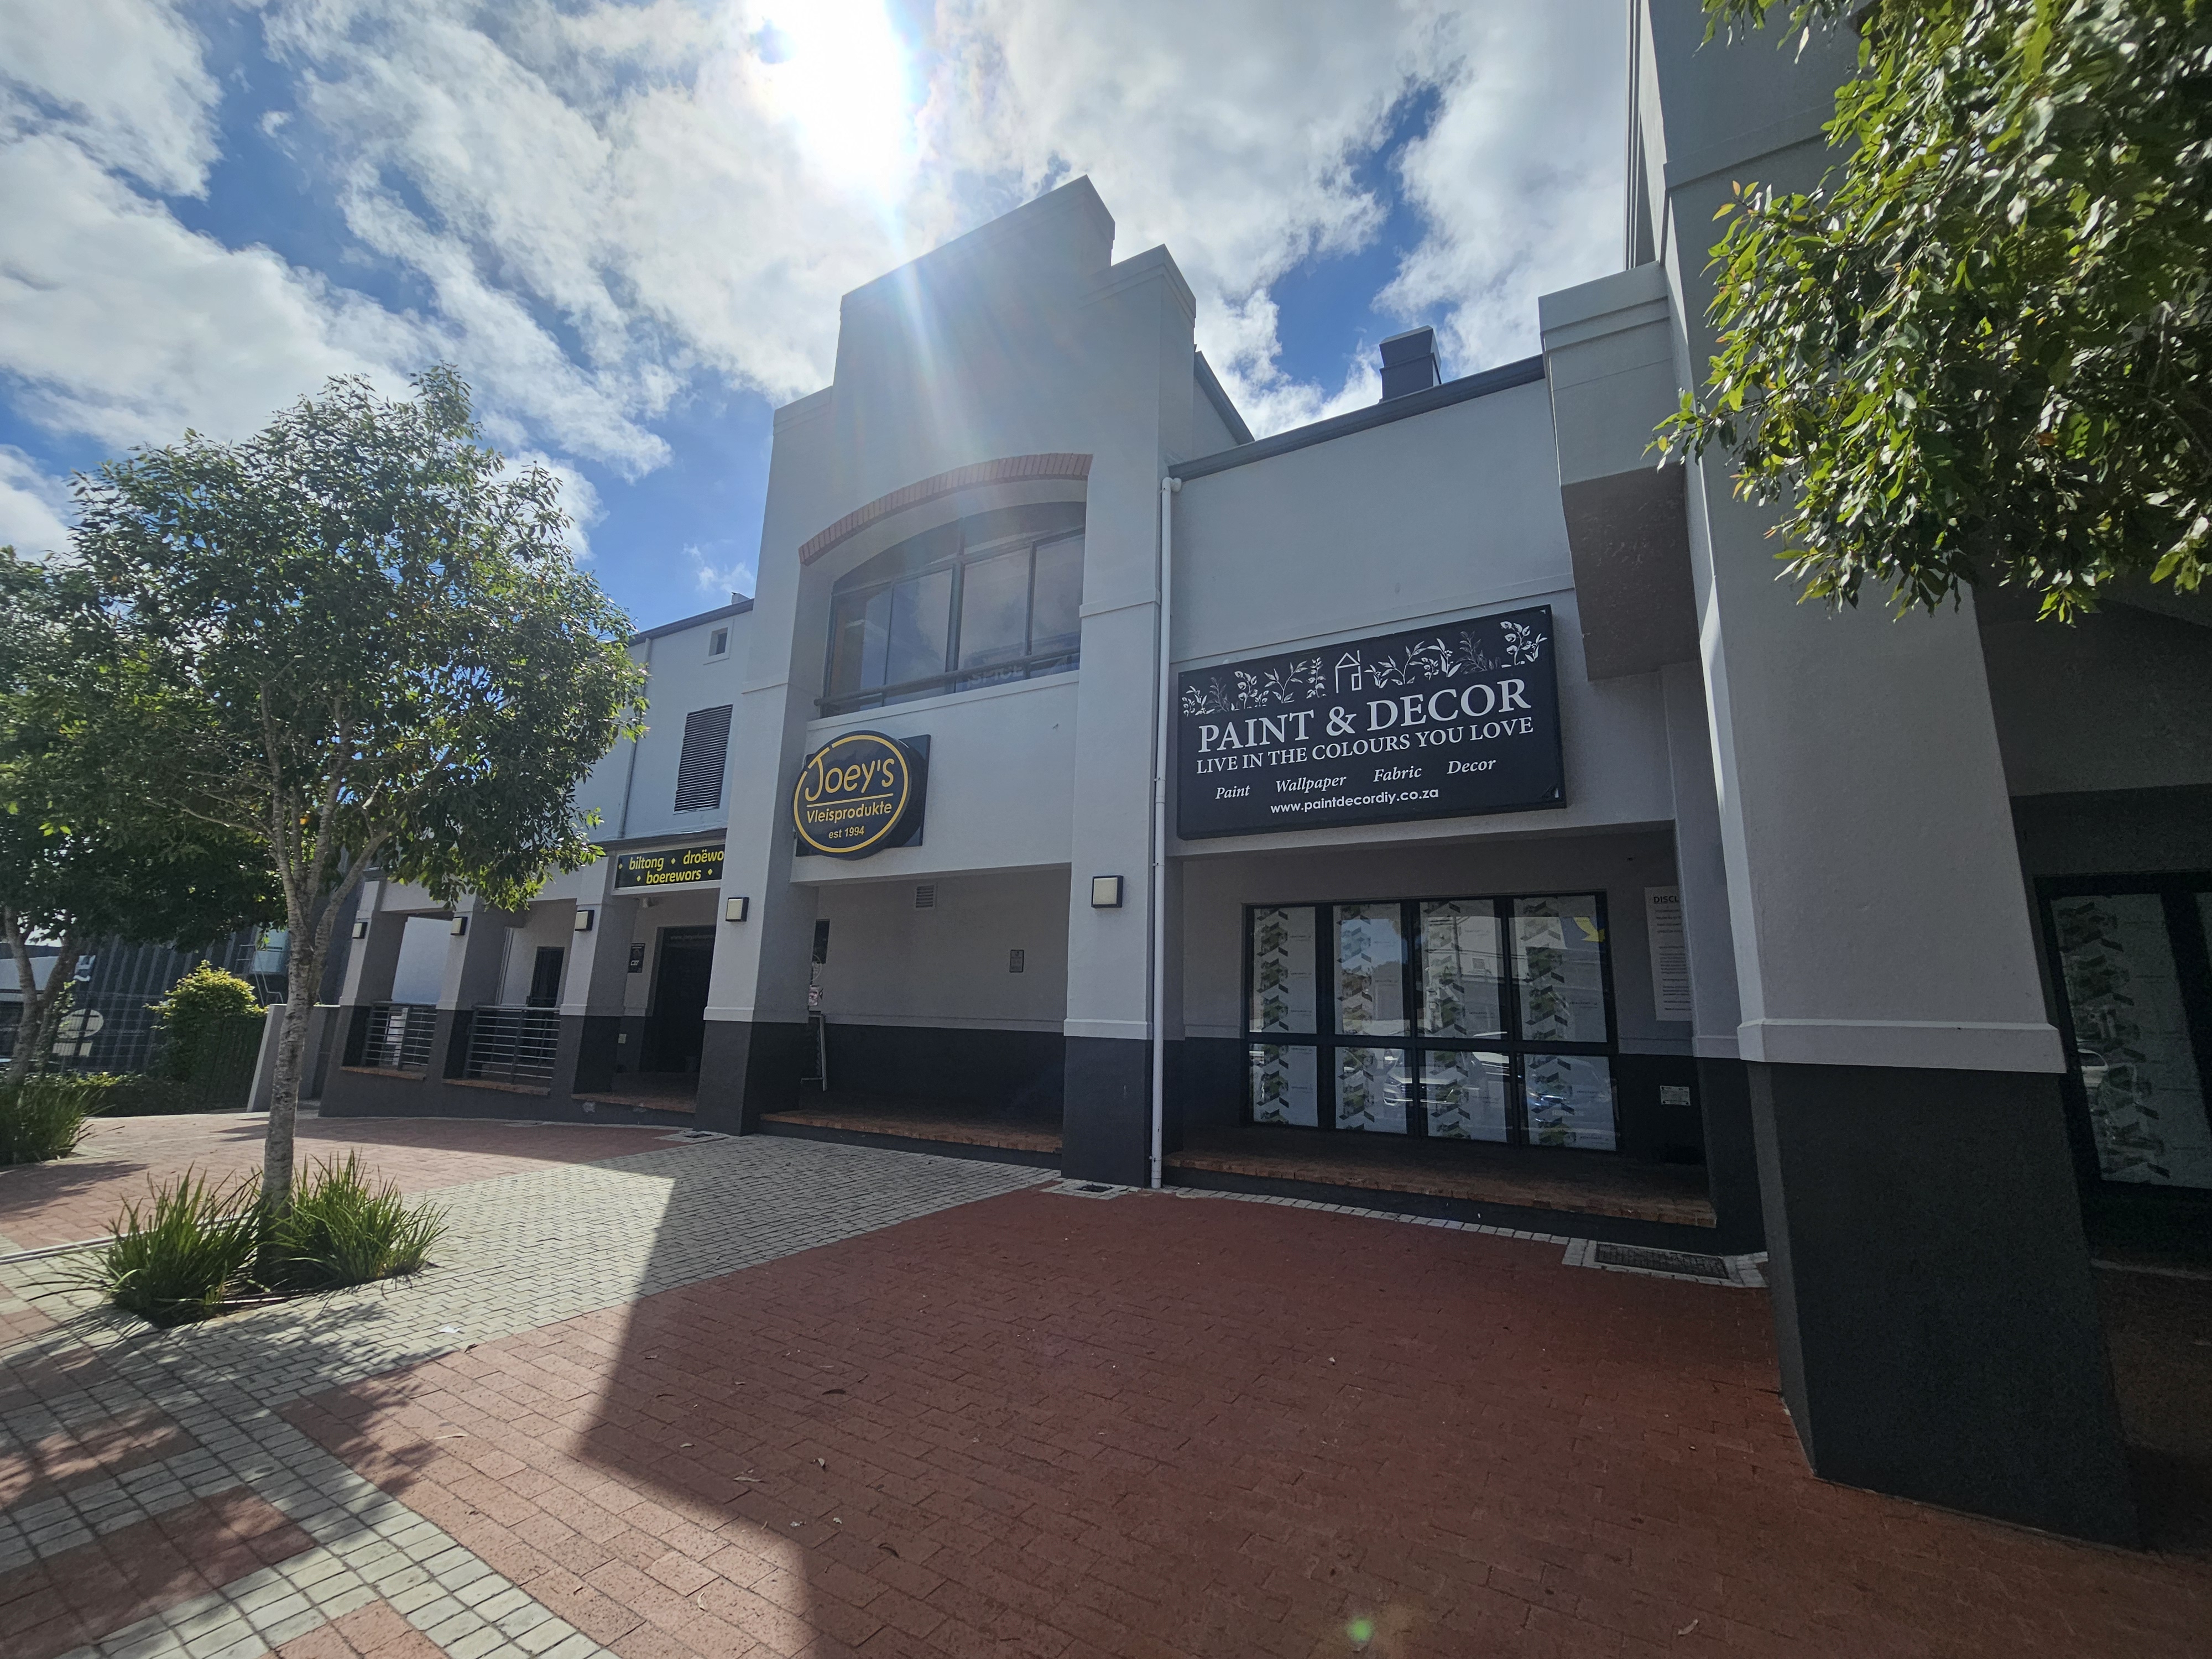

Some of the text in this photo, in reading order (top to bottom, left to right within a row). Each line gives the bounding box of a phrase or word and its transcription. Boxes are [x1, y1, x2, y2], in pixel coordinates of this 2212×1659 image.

[1198, 679, 1532, 753] PAINT & DECOR
[1196, 716, 1534, 774] LIVE IN THE COLOURS YOU LOVE
[805, 747, 895, 802] Joey's
[1215, 759, 1496, 800] Paint Wallpaper Fabric Decor
[806, 801, 893, 824] Vleisprodukte
[1270, 789, 1439, 814] www.paintdecordiy.co.za
[828, 825, 865, 839] est 1994
[628, 855, 664, 872] biltong
[645, 869, 702, 884] boerewors
